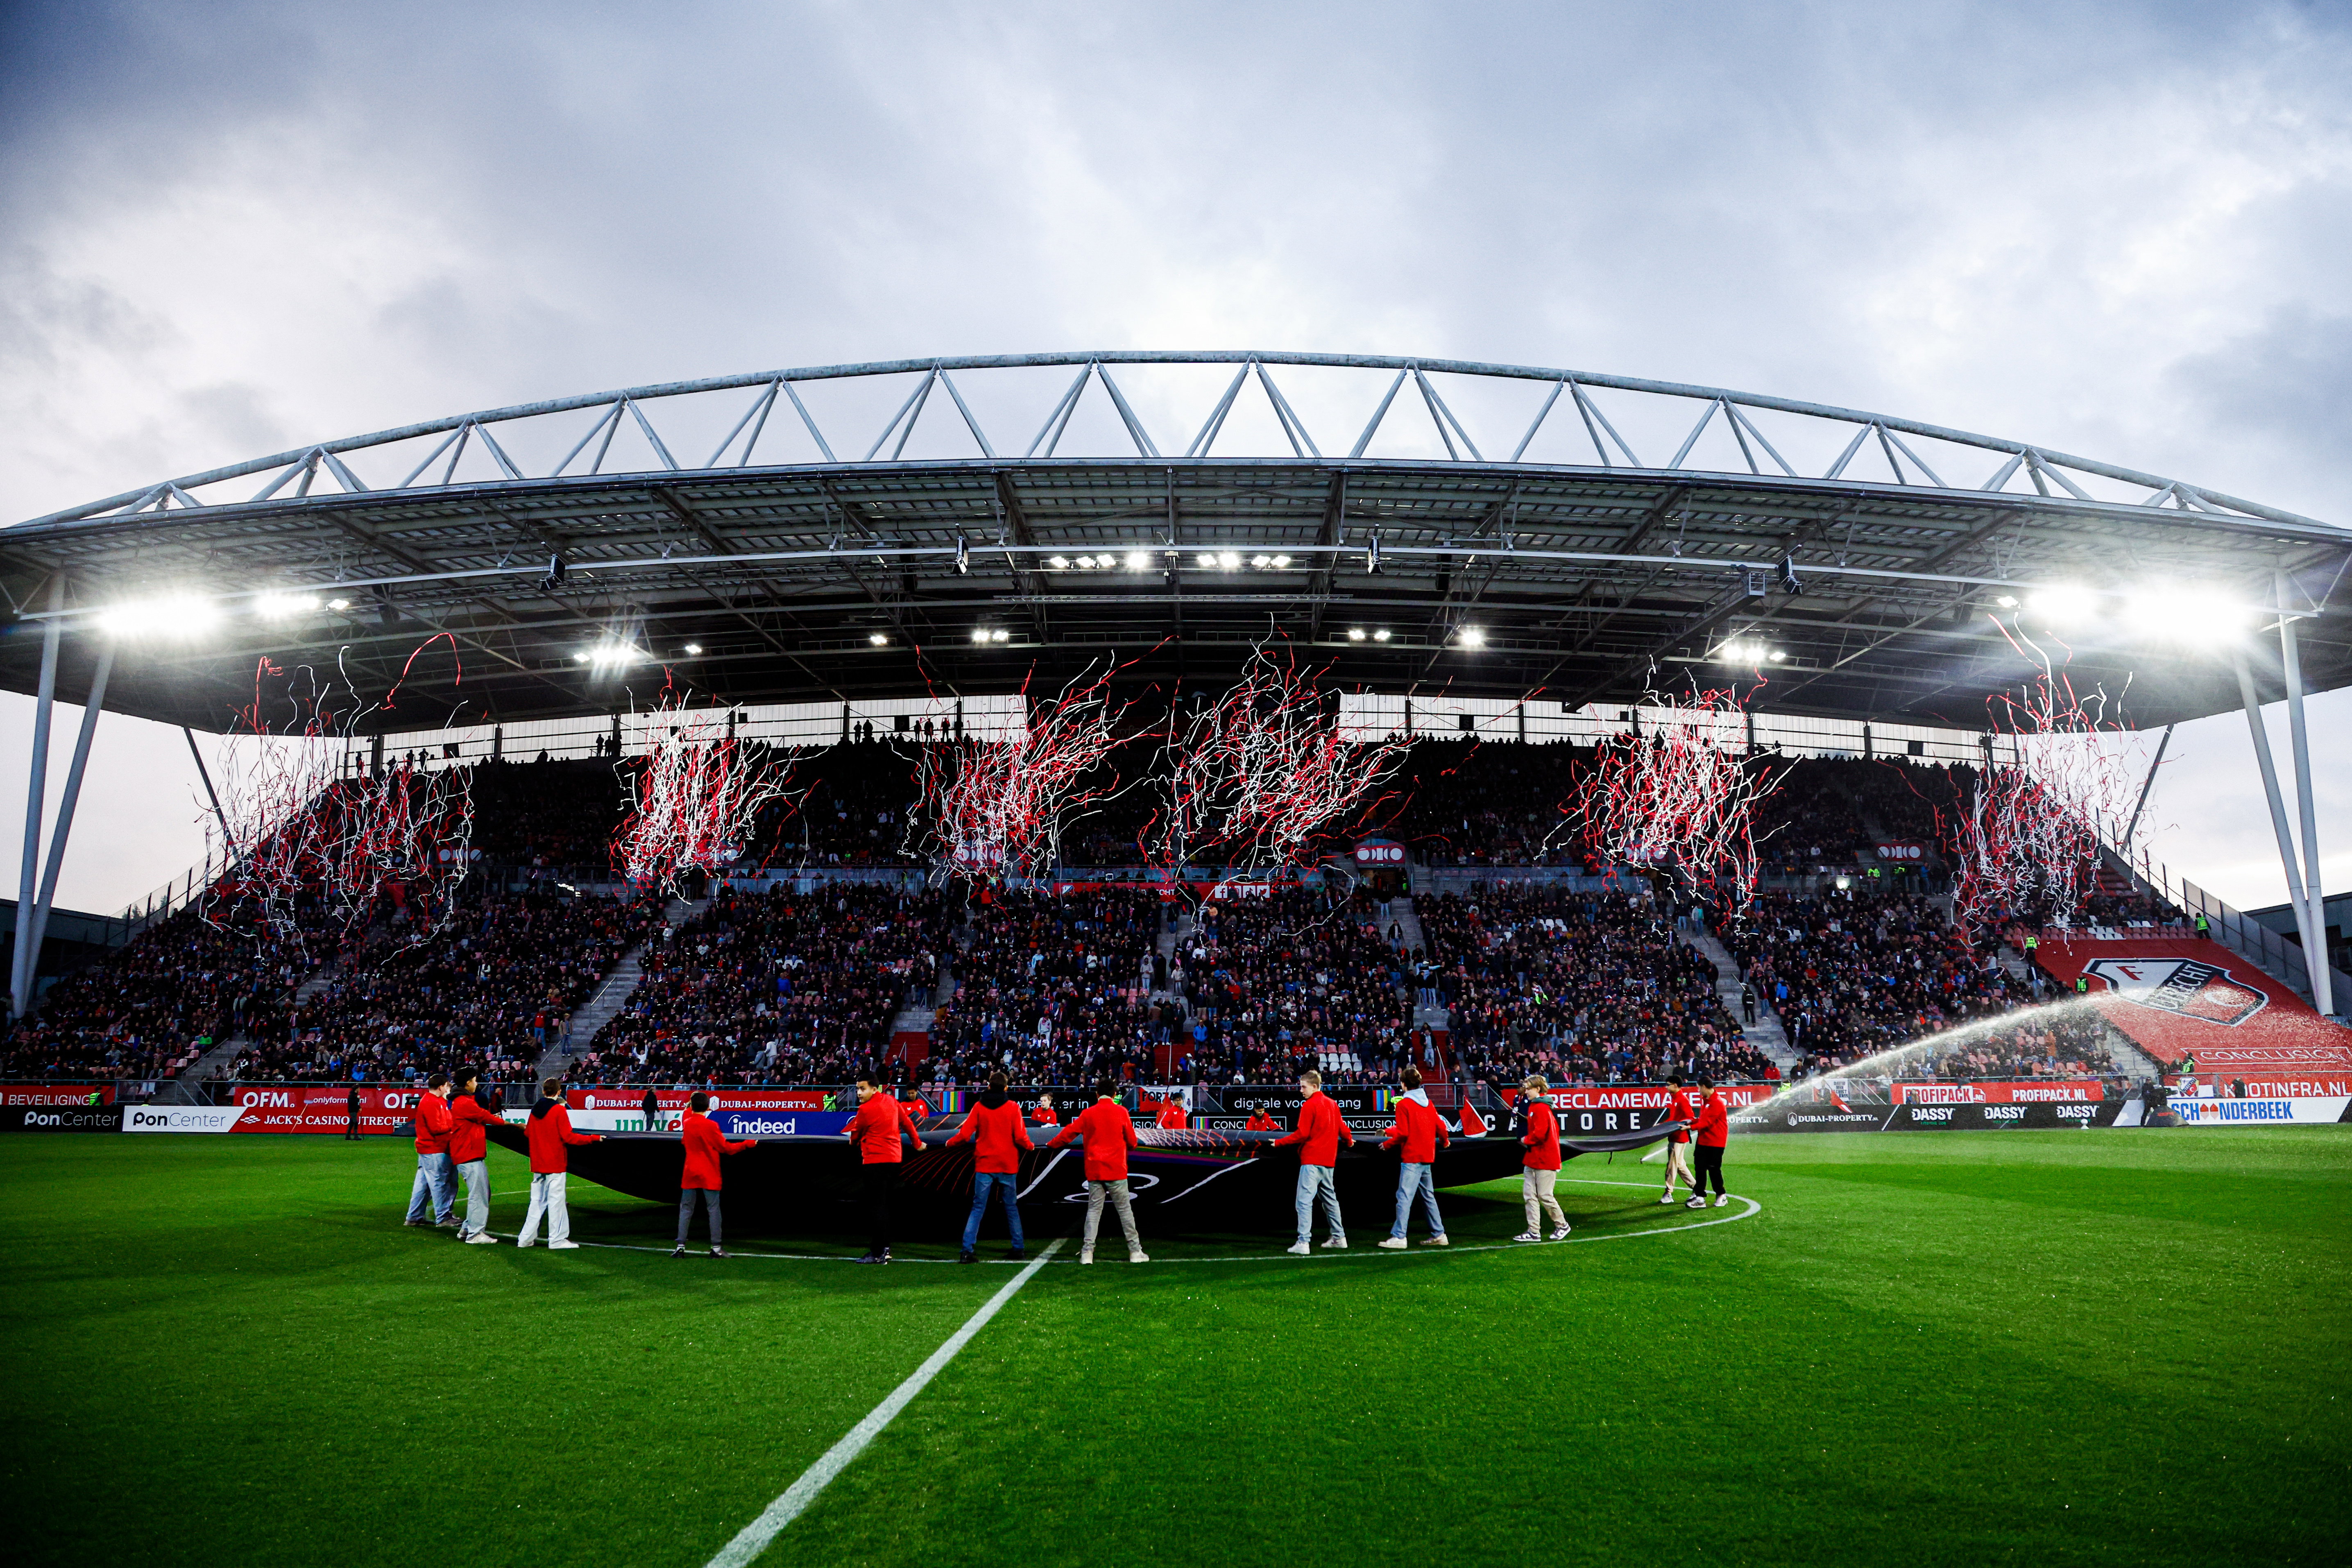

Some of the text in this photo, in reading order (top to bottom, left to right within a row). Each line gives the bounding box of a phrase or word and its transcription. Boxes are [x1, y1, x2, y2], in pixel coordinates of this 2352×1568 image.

[2116, 965, 2143, 980] F
[2148, 964, 2212, 1009] UTRECHT
[2204, 991, 2244, 1007] C
[2013, 1088, 2088, 1102] PROFIPACK.NL
[2224, 1081, 2352, 1097] KOTINFRA.NL
[8, 1095, 90, 1105] BEVEILIGING
[596, 1099, 687, 1108] DUBAI-PRERTY.N
[1079, 1099, 1088, 1108] in
[1552, 1092, 1758, 1108] RECLAMEMAE.NL
[25, 1111, 118, 1126] PonCenter
[1799, 1114, 1878, 1122] DUBAI-PROPERTY.NL
[1911, 1108, 1955, 1121] DASSY
[1984, 1106, 2026, 1119] DASSY
[2056, 1106, 2098, 1118] DASSY
[133, 1112, 226, 1126] PonCenter
[264, 1115, 302, 1125] JACK'S
[306, 1116, 350, 1125] CASINO
[616, 1113, 683, 1131] unvé
[728, 1115, 795, 1134] indeed
[1213, 1121, 1281, 1129] CONCLN
[1343, 1120, 1396, 1128] NCLUSIO
